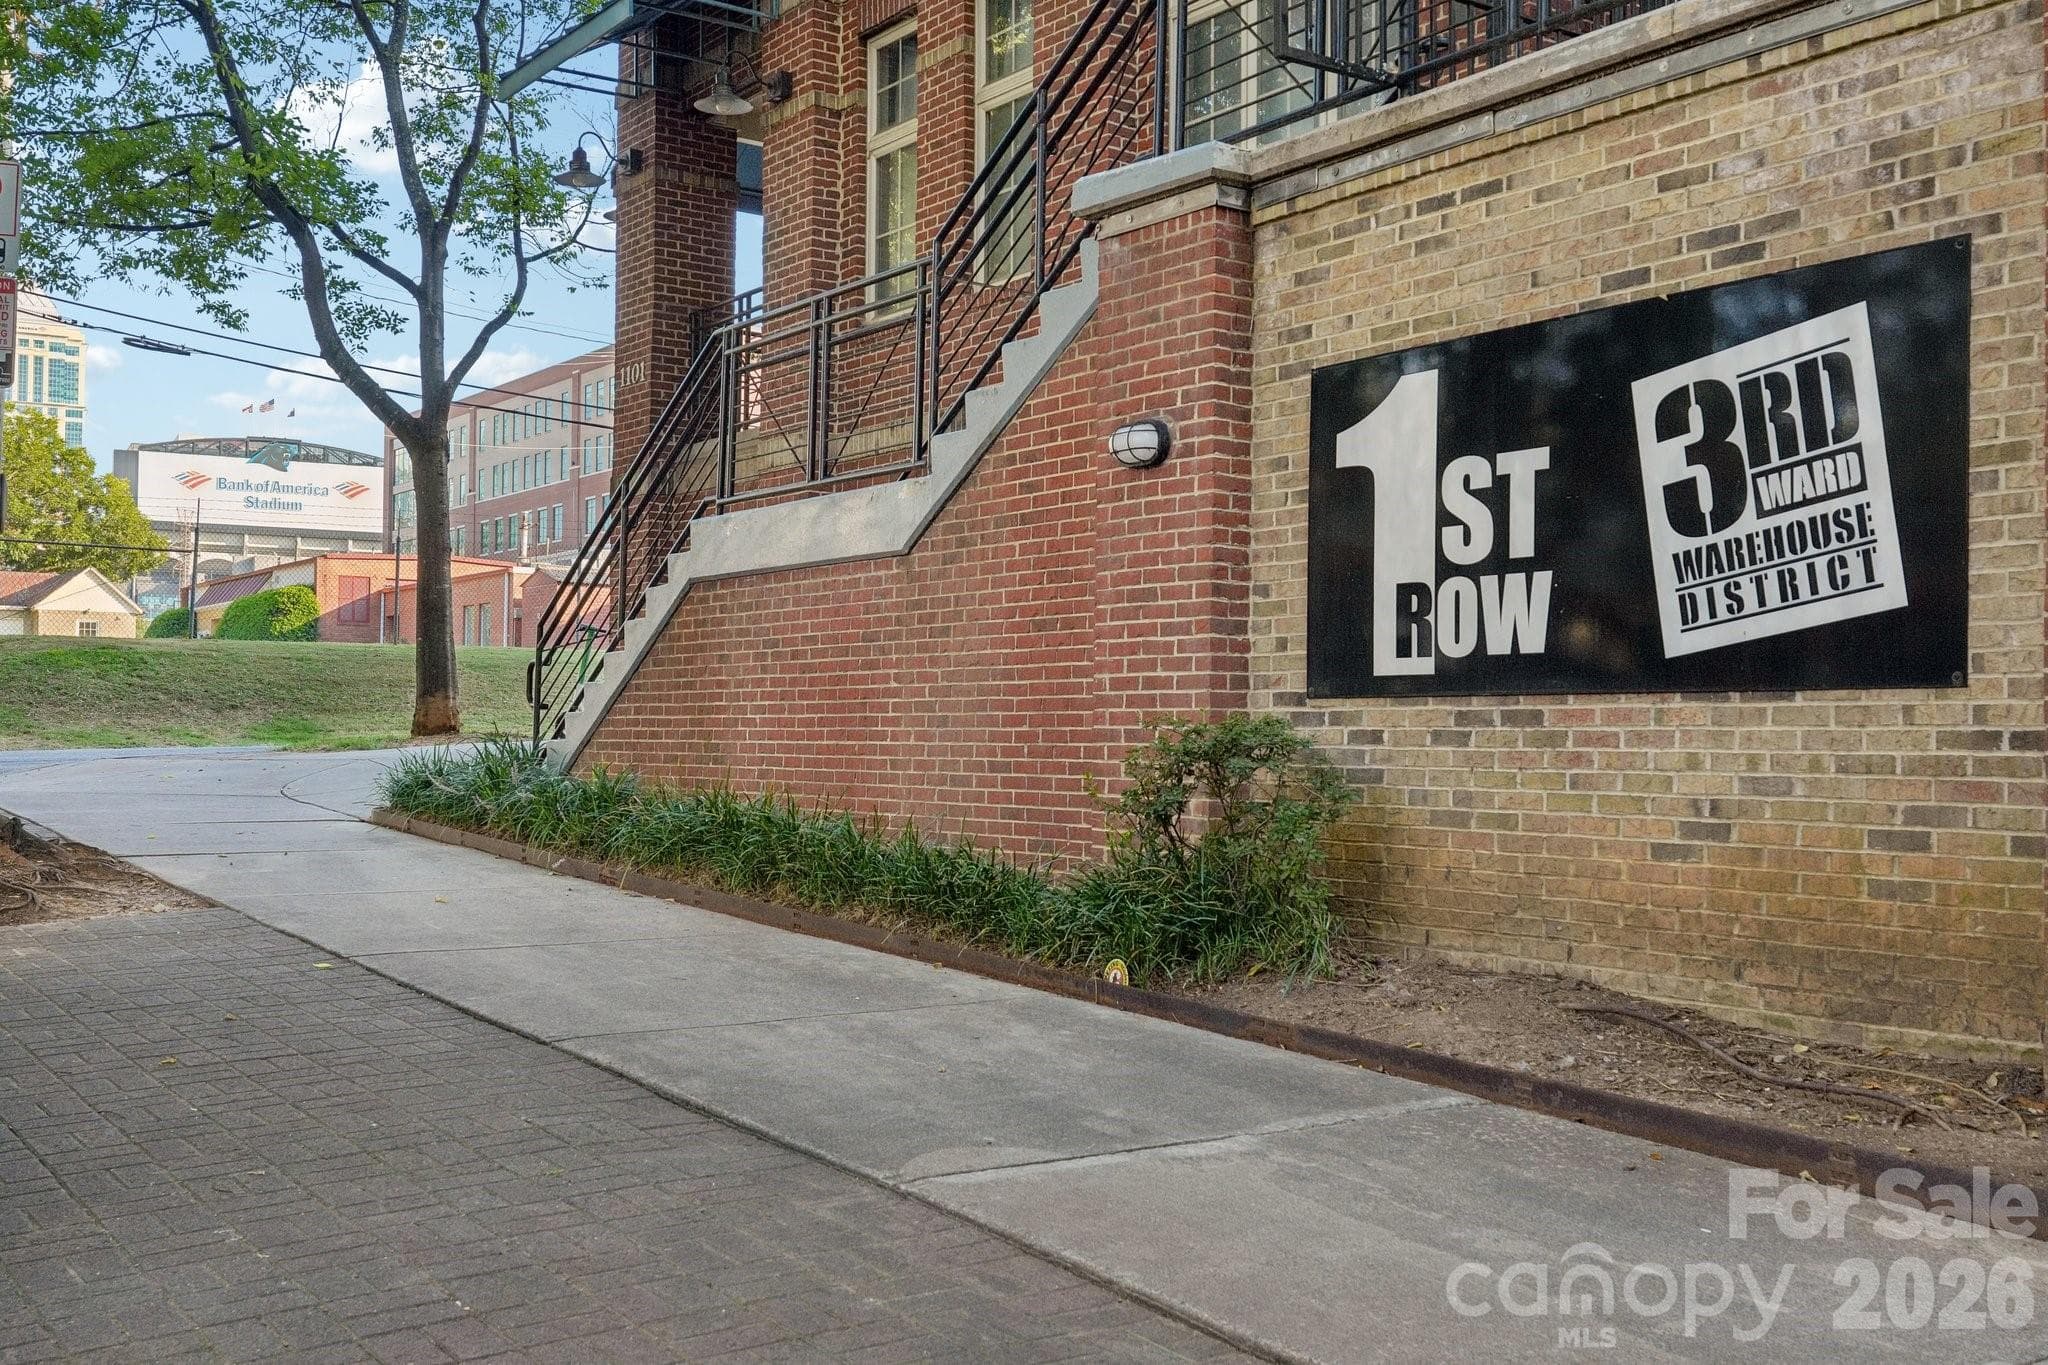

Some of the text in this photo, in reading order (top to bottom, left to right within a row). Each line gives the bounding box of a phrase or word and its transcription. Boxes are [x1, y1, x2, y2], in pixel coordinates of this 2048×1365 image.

[620, 361, 646, 388] 1101
[1655, 351, 1860, 538] 3RD
[216, 477, 329, 496] Bank of America
[244, 495, 303, 511] Stadium
[1756, 451, 1862, 511] WARD
[1672, 502, 1876, 585] WAREHOUSE
[1396, 570, 1553, 658] ROW
[1678, 546, 1878, 627] DISTRICT
